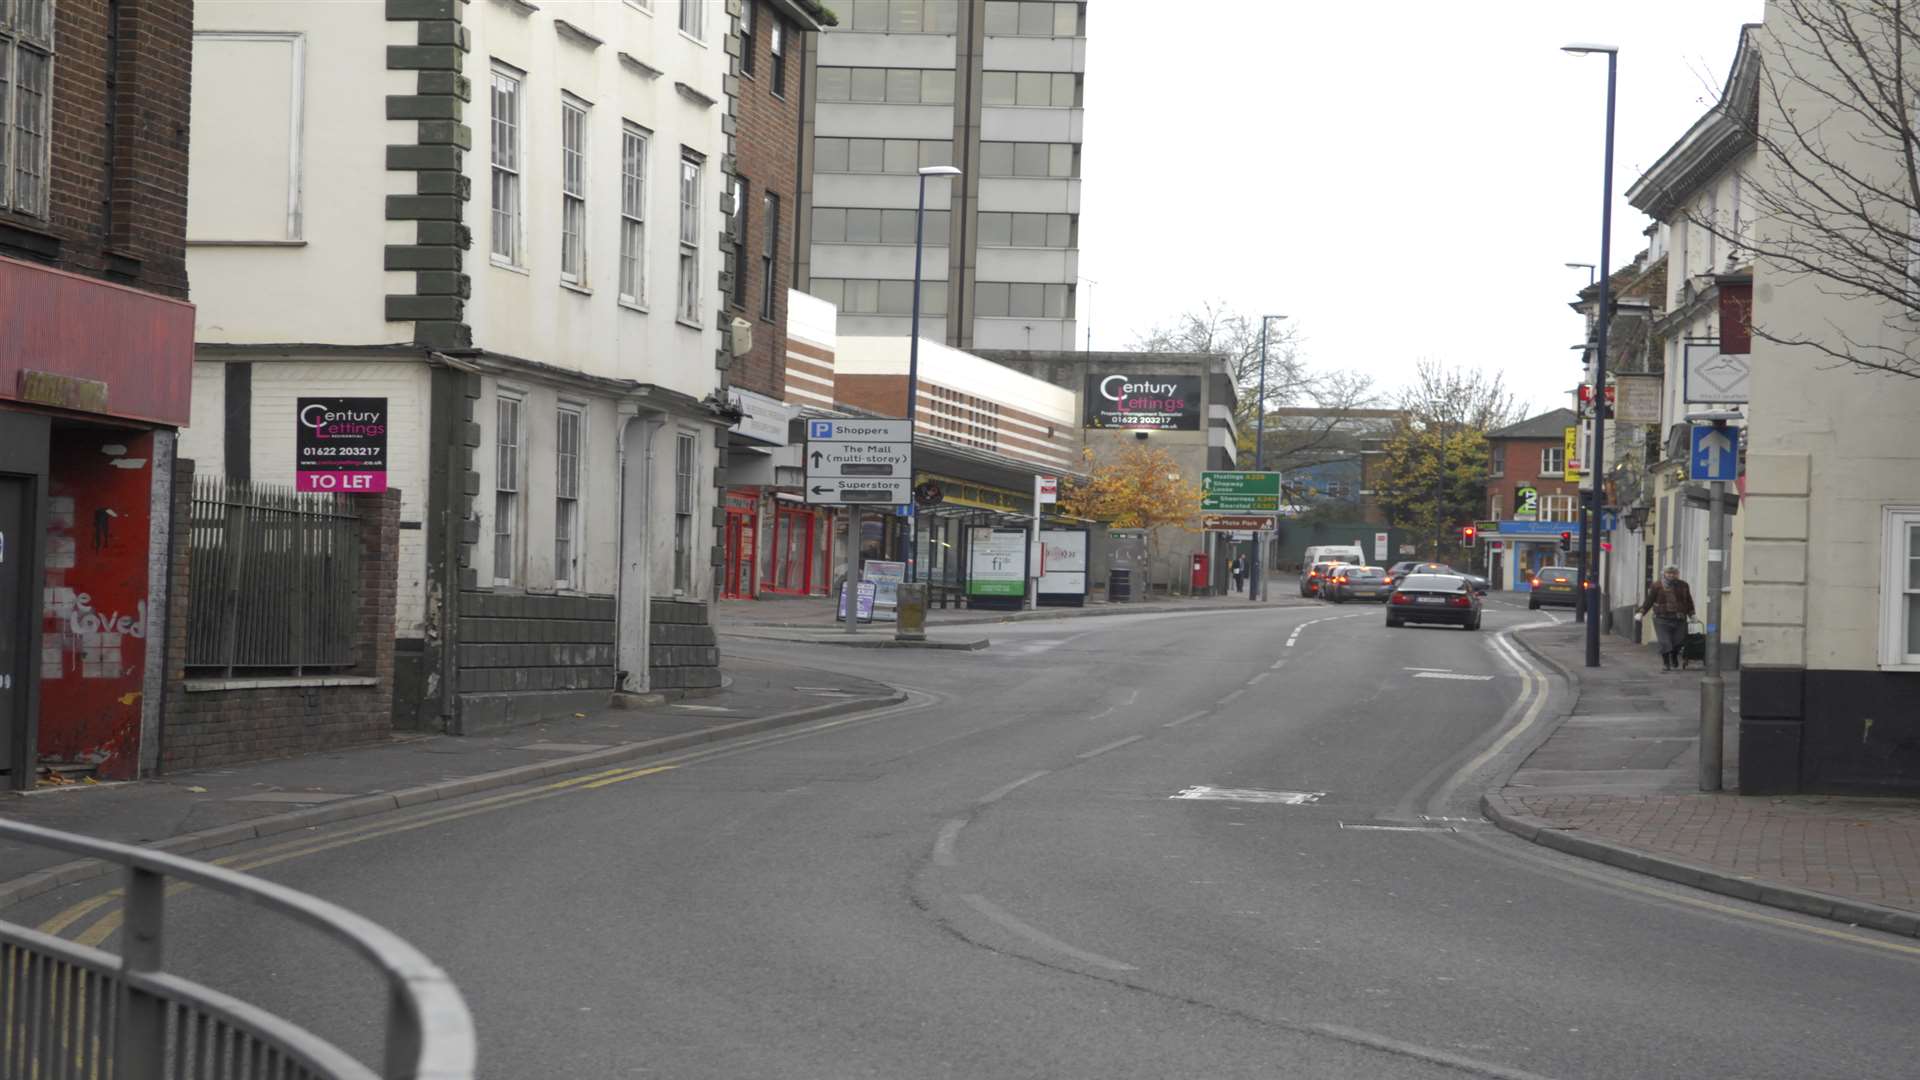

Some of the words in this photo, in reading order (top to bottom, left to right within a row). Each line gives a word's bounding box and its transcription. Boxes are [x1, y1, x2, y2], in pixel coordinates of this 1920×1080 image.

[1100, 375, 1177, 401] Century
[1117, 384, 1185, 412] Lettings
[301, 404, 380, 428] Century
[1112, 416, 1137, 424] 01622
[1140, 416, 1171, 425] 203217
[316, 415, 385, 438] Lettings
[836, 426, 889, 436] Shoppers
[303, 447, 336, 456] 01622
[339, 447, 380, 456] 203217
[844, 445, 863, 454] The
[867, 445, 891, 454] Mall
[826, 454, 908, 464] (multi-storey)
[310, 475, 336, 489] TO
[343, 475, 373, 489] LET
[838, 481, 900, 490] Superstore
